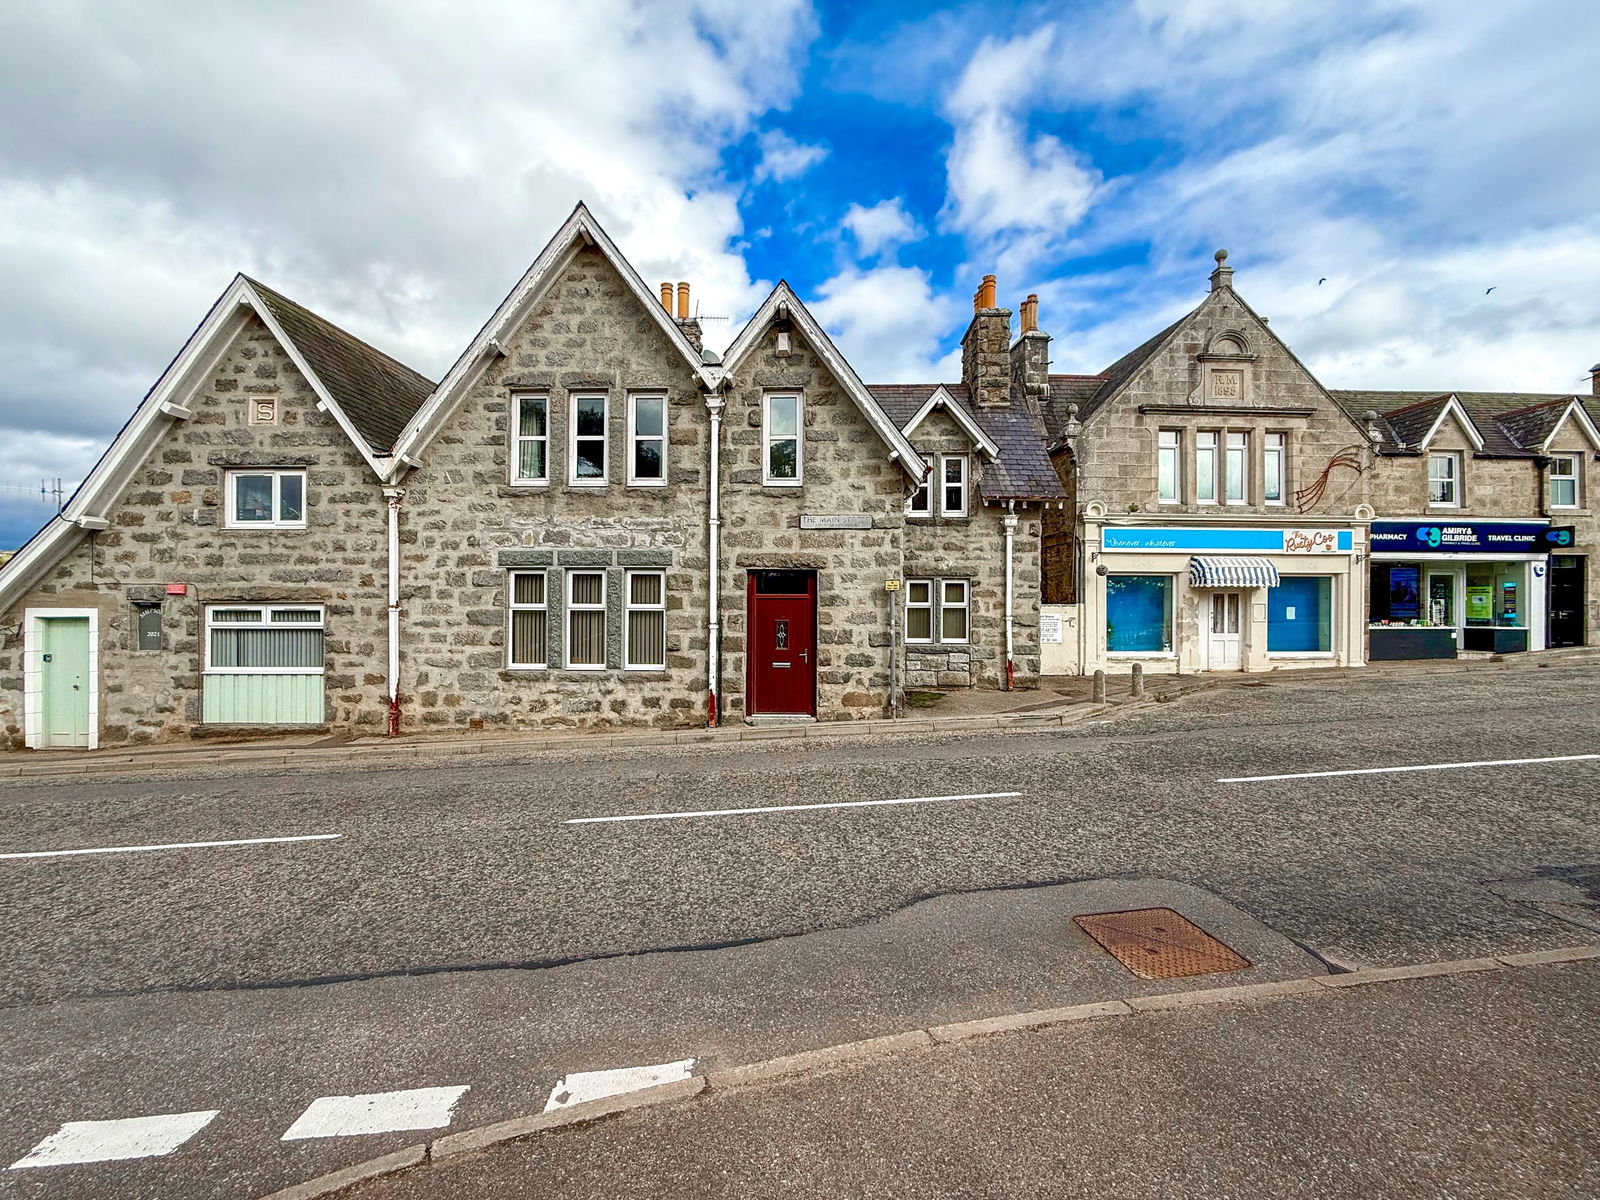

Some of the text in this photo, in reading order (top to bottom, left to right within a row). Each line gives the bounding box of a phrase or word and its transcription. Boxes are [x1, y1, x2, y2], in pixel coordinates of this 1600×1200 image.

[257, 403, 273, 420] S
[1369, 533, 1408, 541] PHARMACY
[1441, 534, 1478, 542] GILBRIDE
[139, 608, 162, 619] SIMPSO
